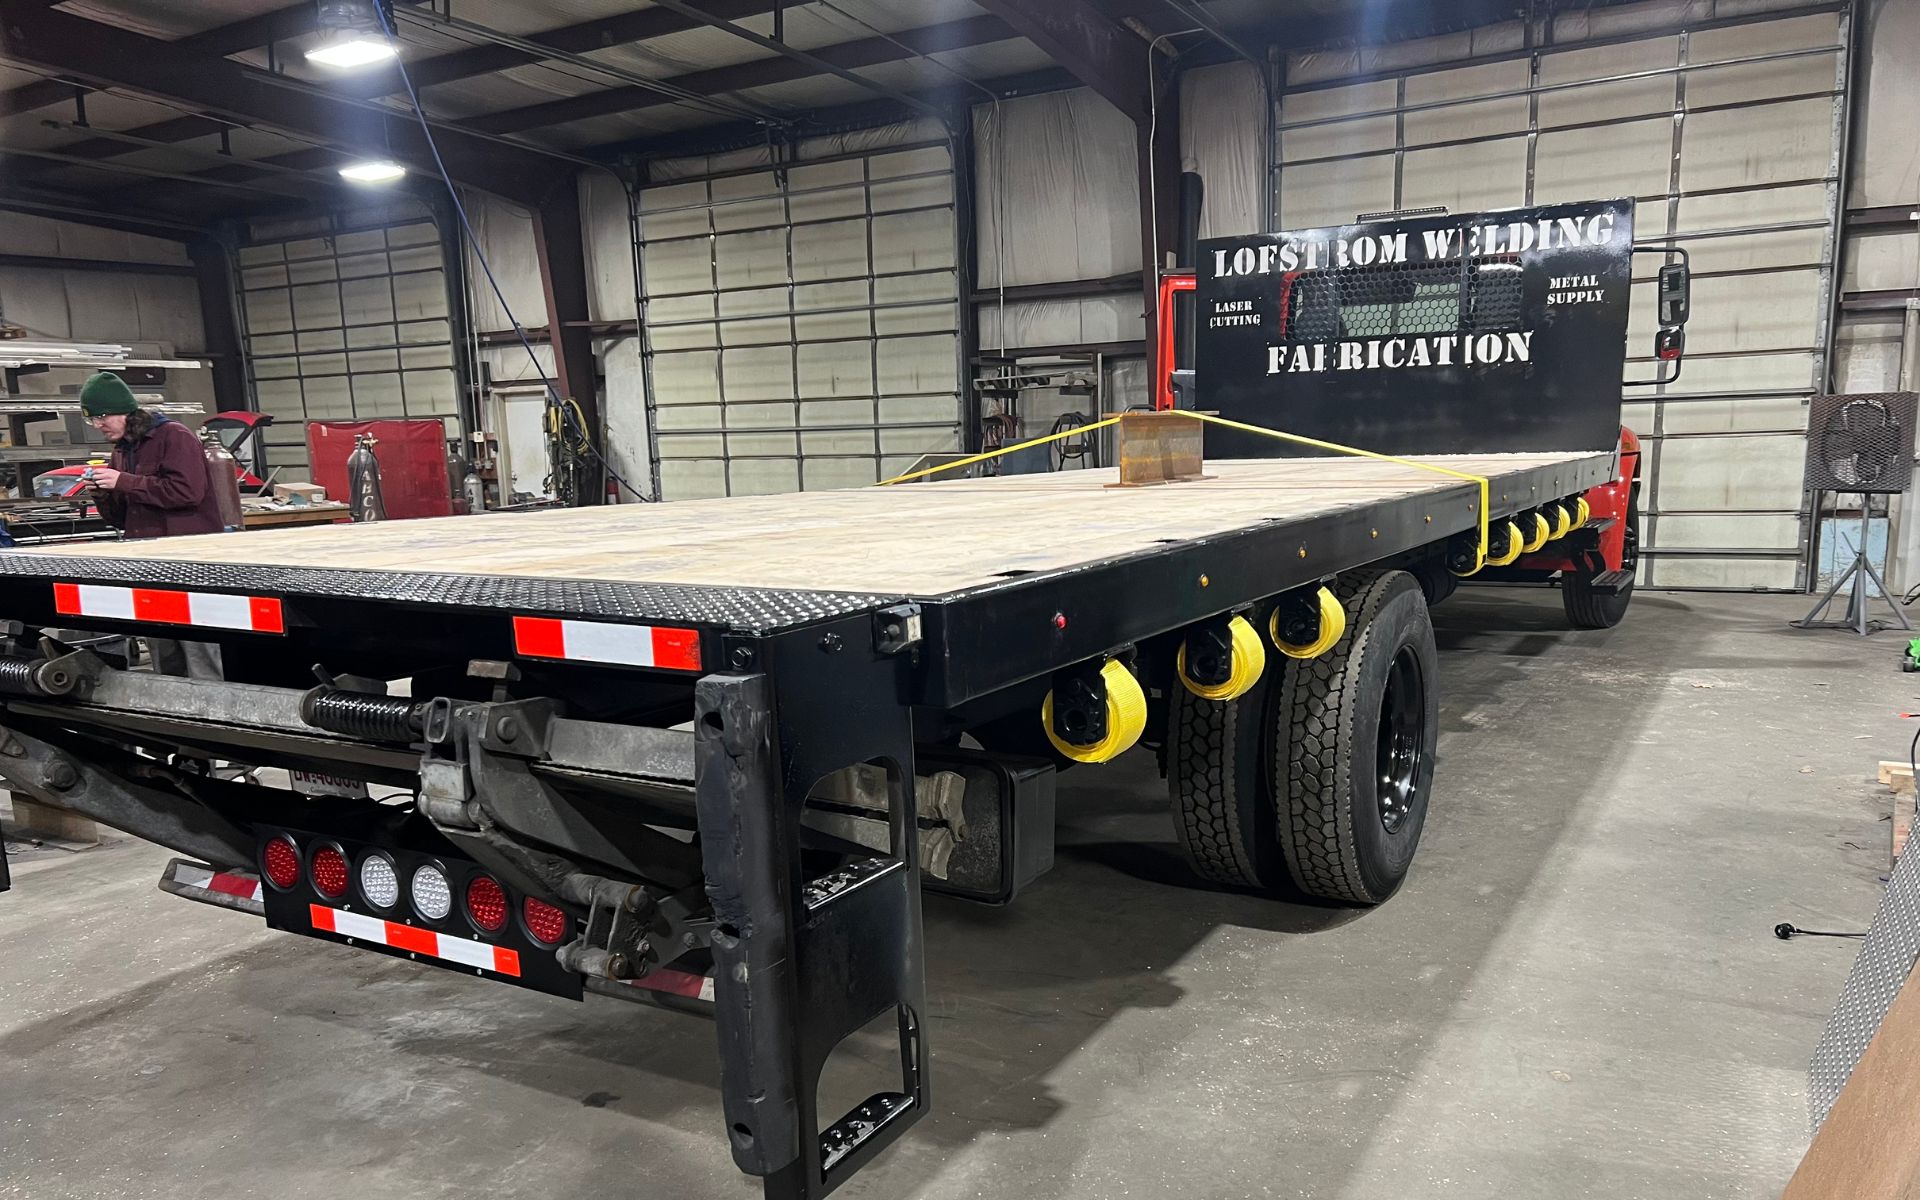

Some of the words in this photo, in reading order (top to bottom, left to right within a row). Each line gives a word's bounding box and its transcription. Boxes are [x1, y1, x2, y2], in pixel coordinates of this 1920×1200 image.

[1213, 233, 1408, 278] LOFSTROM
[1422, 213, 1614, 260] WELDING
[1549, 274, 1599, 289] METAL
[1546, 289, 1605, 306] SUPPLY
[1215, 300, 1253, 313] LASER
[1209, 313, 1261, 328] CUTTING
[1267, 331, 1533, 374] FABRICATION
